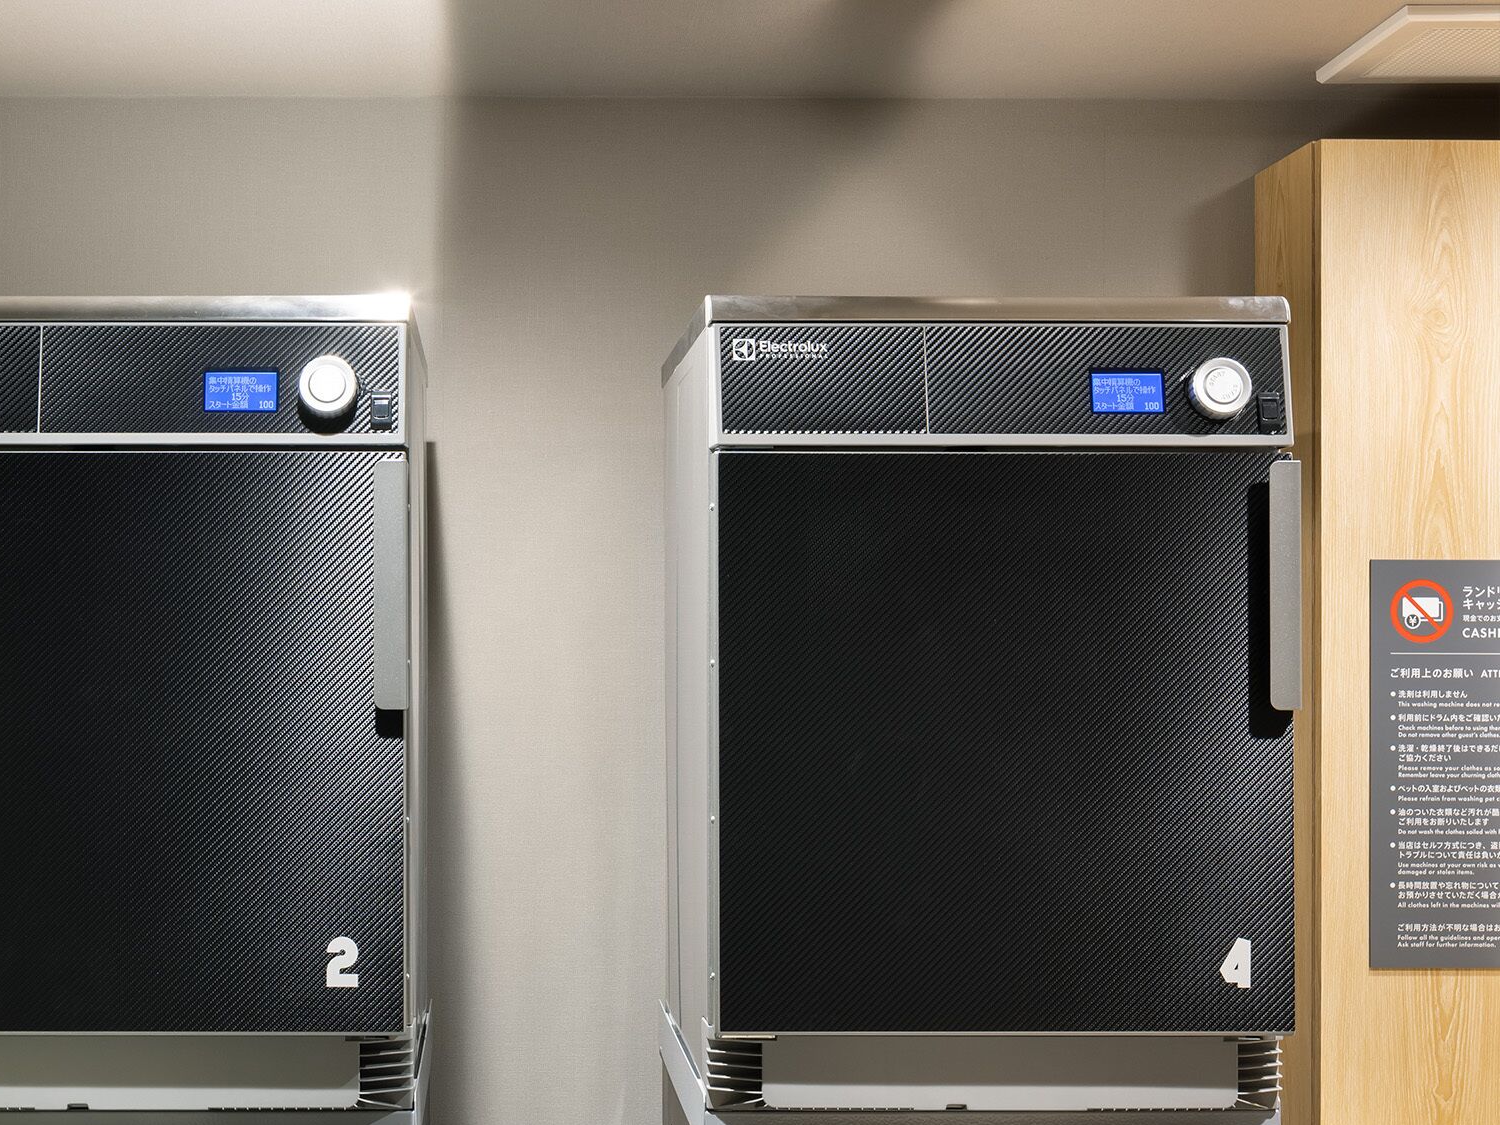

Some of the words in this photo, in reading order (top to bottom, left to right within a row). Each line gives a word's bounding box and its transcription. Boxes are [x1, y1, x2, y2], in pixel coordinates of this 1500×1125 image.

[760, 340, 828, 352] Electrolux
[259, 400, 274, 409] 100
[1144, 402, 1159, 410] 100
[1462, 586, 1500, 598] ランド
[1390, 668, 1474, 679] ご利用上のお願い
[1481, 668, 1500, 679] ATT
[1398, 690, 1468, 698] 洗剤は利用しません
[1412, 701, 1437, 709] washing
[1398, 744, 1500, 752] 洗濯・乾燥終了後はできるだ
[1398, 754, 1451, 762] ご協力ください
[1446, 772, 1460, 780] your
[1398, 818, 1489, 826] ご利用をお断りいたします
[1398, 841, 1500, 850] 当店はセルフ方式につき、盗
[1447, 862, 1461, 870] your
[326, 936, 359, 988] 2
[1220, 937, 1251, 988] 4
